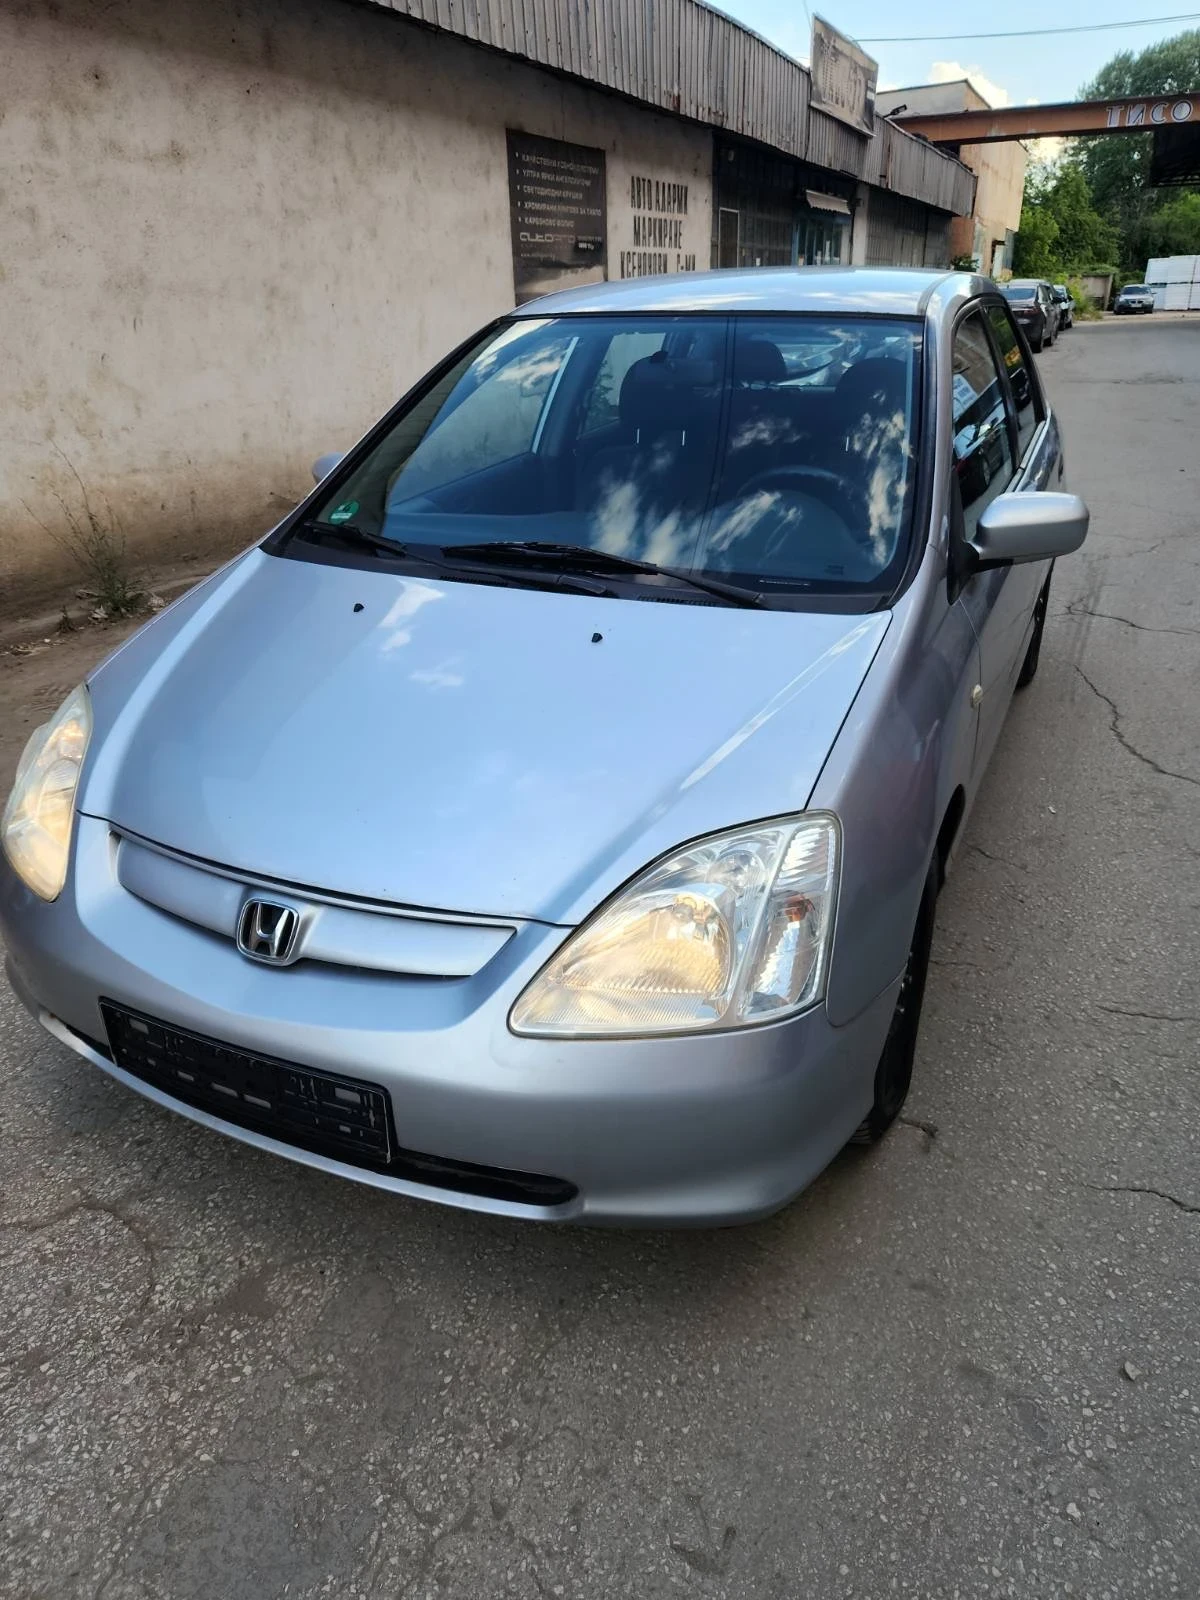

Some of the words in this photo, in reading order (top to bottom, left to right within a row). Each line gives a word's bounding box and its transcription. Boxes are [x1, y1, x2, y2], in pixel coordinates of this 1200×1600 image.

[1106, 100, 1193, 127] ТИСО
[630, 175, 653, 211] АВТО
[654, 180, 689, 215] АЛАРМИ
[633, 215, 683, 250] МАРКИРАНЕ
